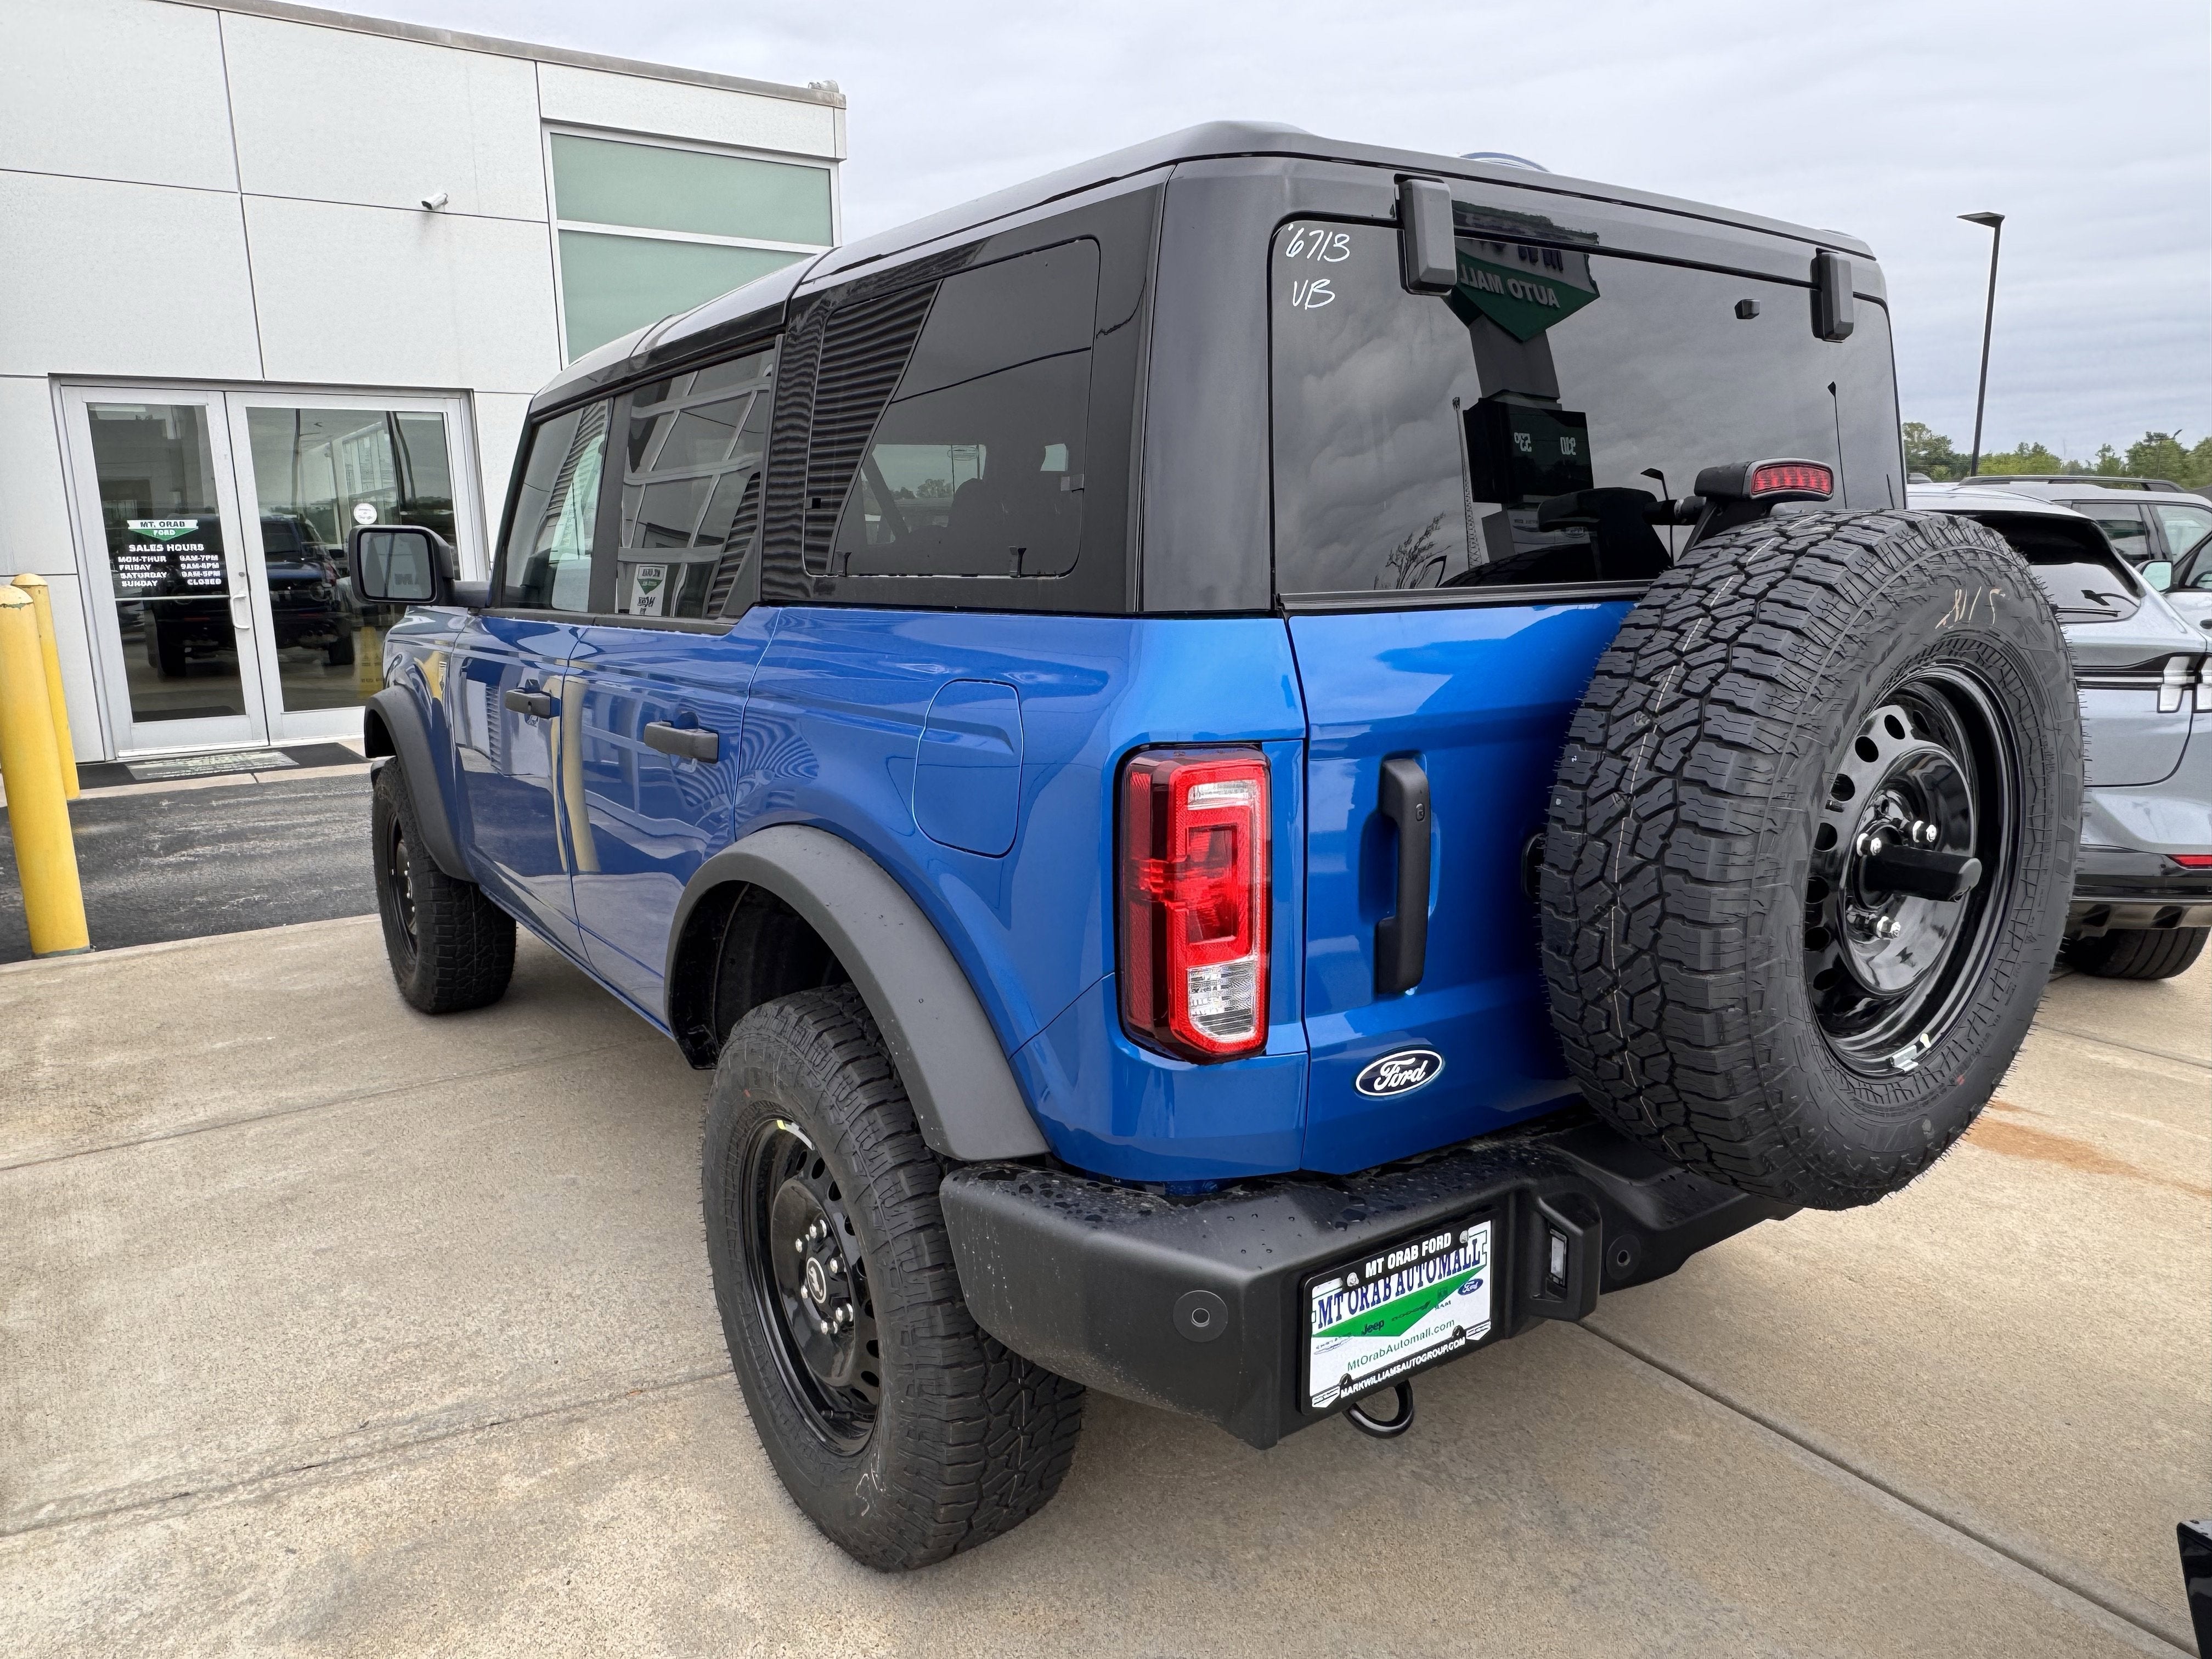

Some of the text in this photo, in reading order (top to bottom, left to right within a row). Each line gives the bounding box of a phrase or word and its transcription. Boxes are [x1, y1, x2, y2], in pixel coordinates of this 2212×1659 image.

[1292, 278, 1336, 311] VB
[128, 543, 205, 552] SALES HOURS
[1373, 1057, 1429, 1091] Ford
[1365, 1232, 1452, 1279] MT ORAB FORD
[1318, 1291, 1344, 1329] MT
[1347, 1277, 1391, 1316] ORAB
[1395, 1238, 1480, 1297] AUTOMALL
[1361, 1319, 1385, 1336] Jeep
[1347, 1319, 1455, 1372] MtOrabAutomall.com
